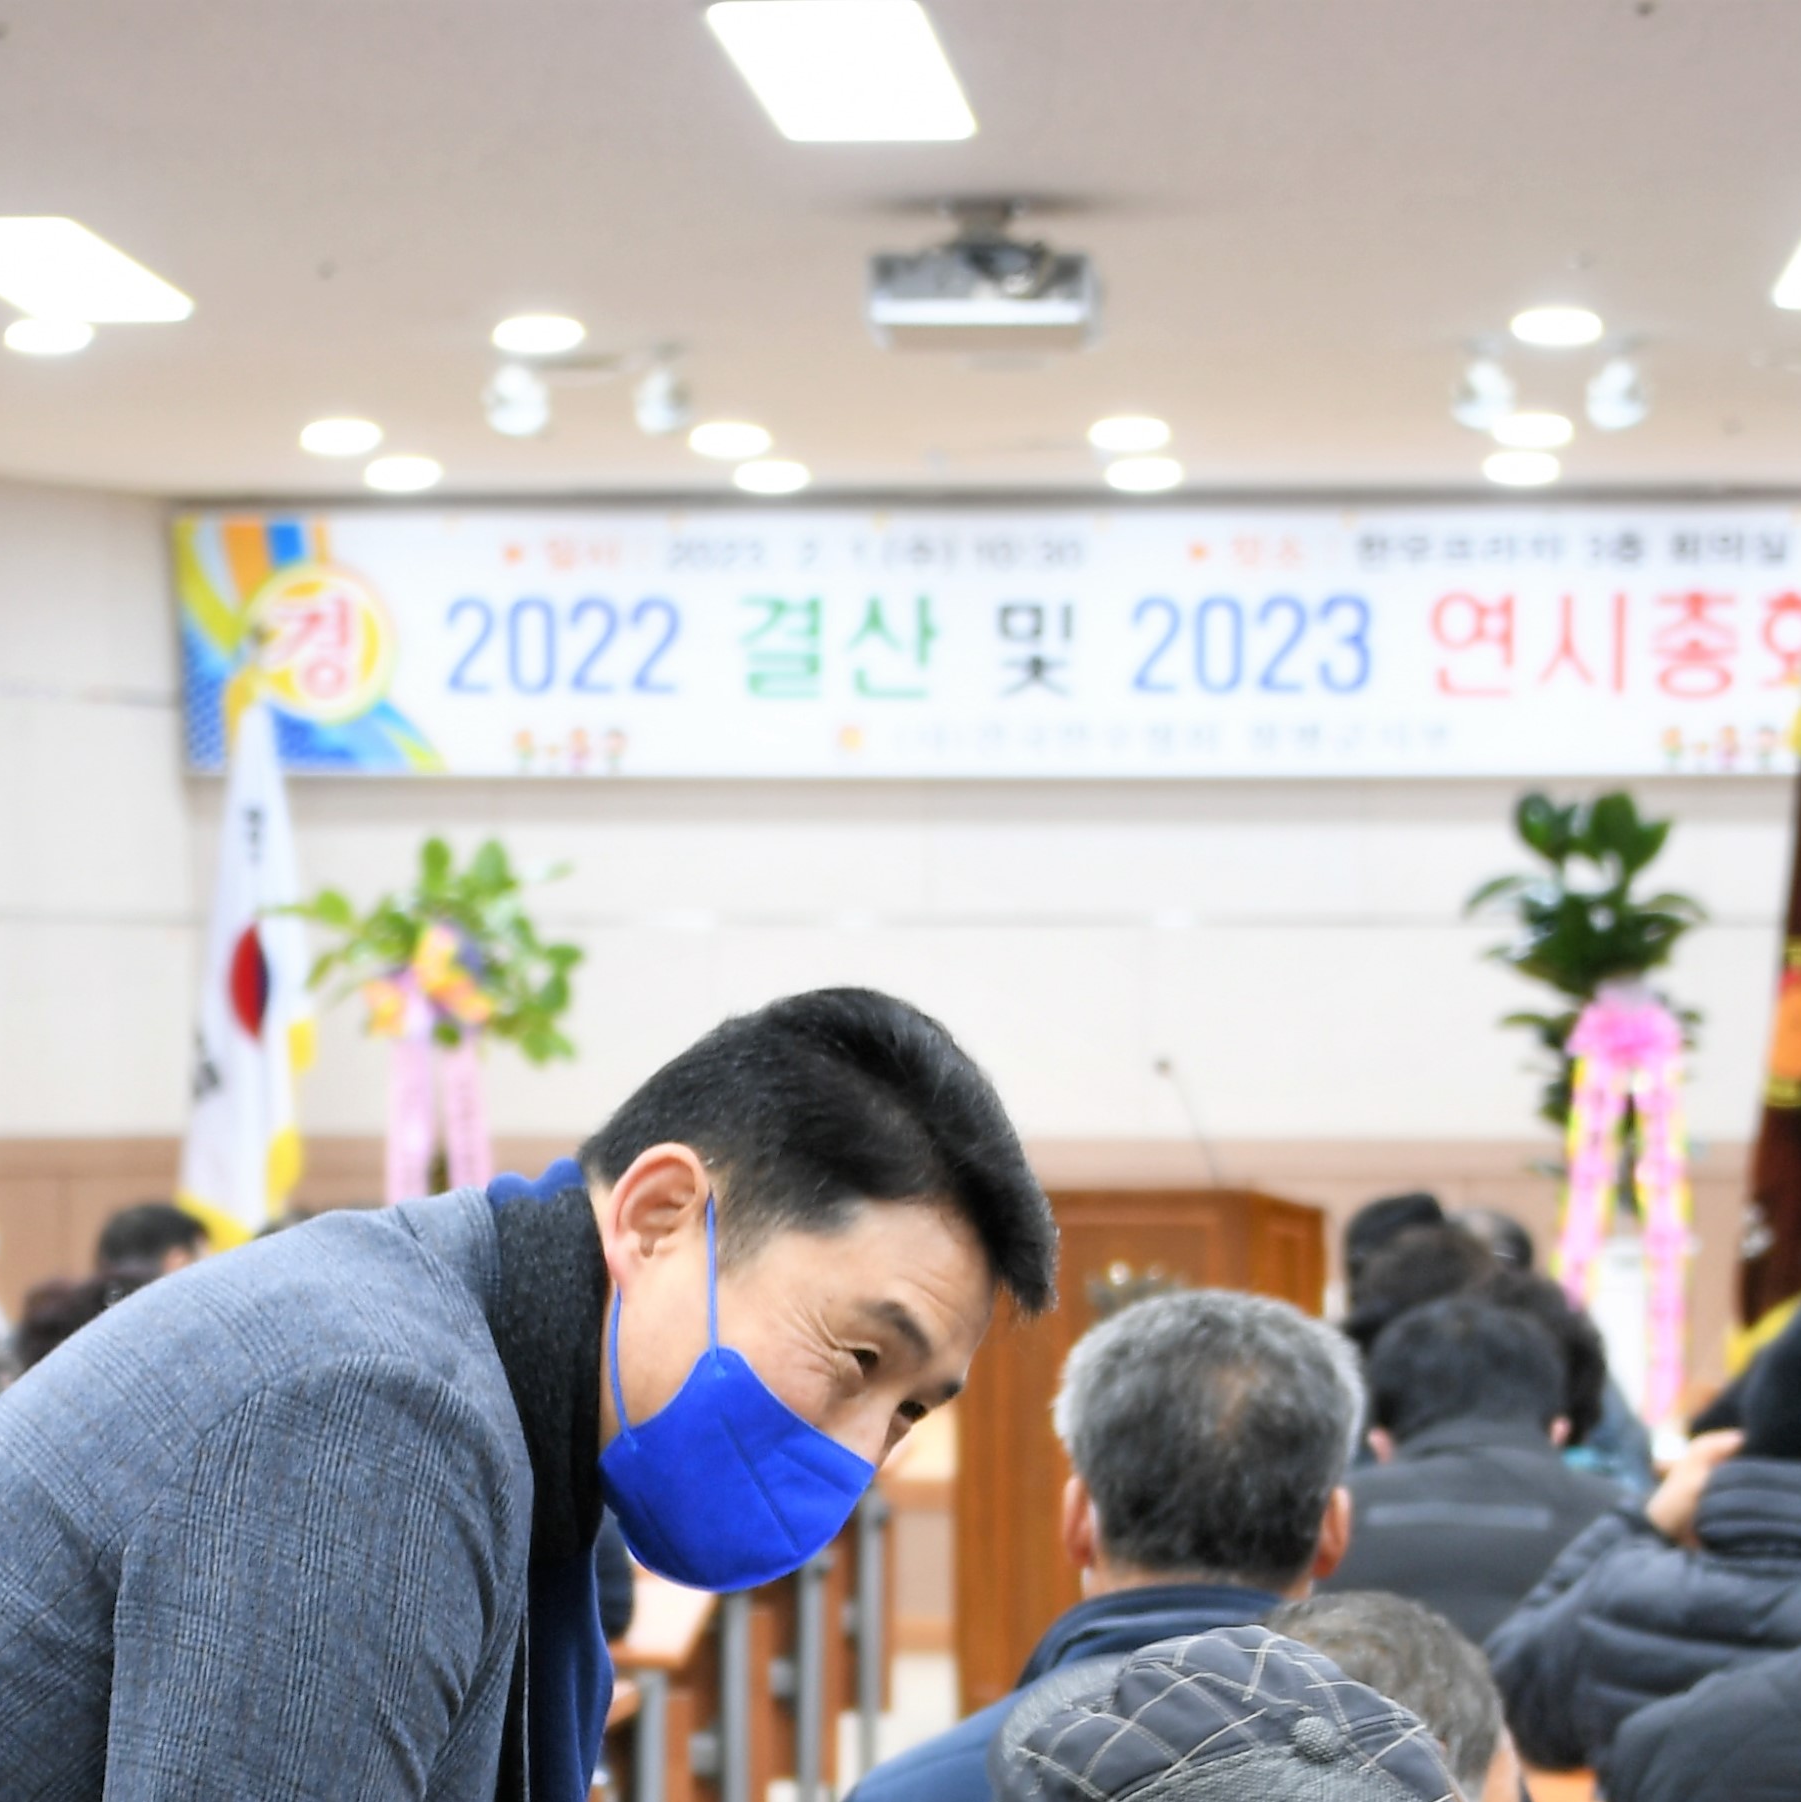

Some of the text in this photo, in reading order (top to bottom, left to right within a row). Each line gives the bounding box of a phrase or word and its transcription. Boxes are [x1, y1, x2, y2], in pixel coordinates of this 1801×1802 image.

[266, 594, 355, 702] 경
[445, 594, 682, 696] 2022
[737, 593, 942, 700] 결산
[995, 600, 1073, 698] 및
[1129, 594, 1373, 694] 2023
